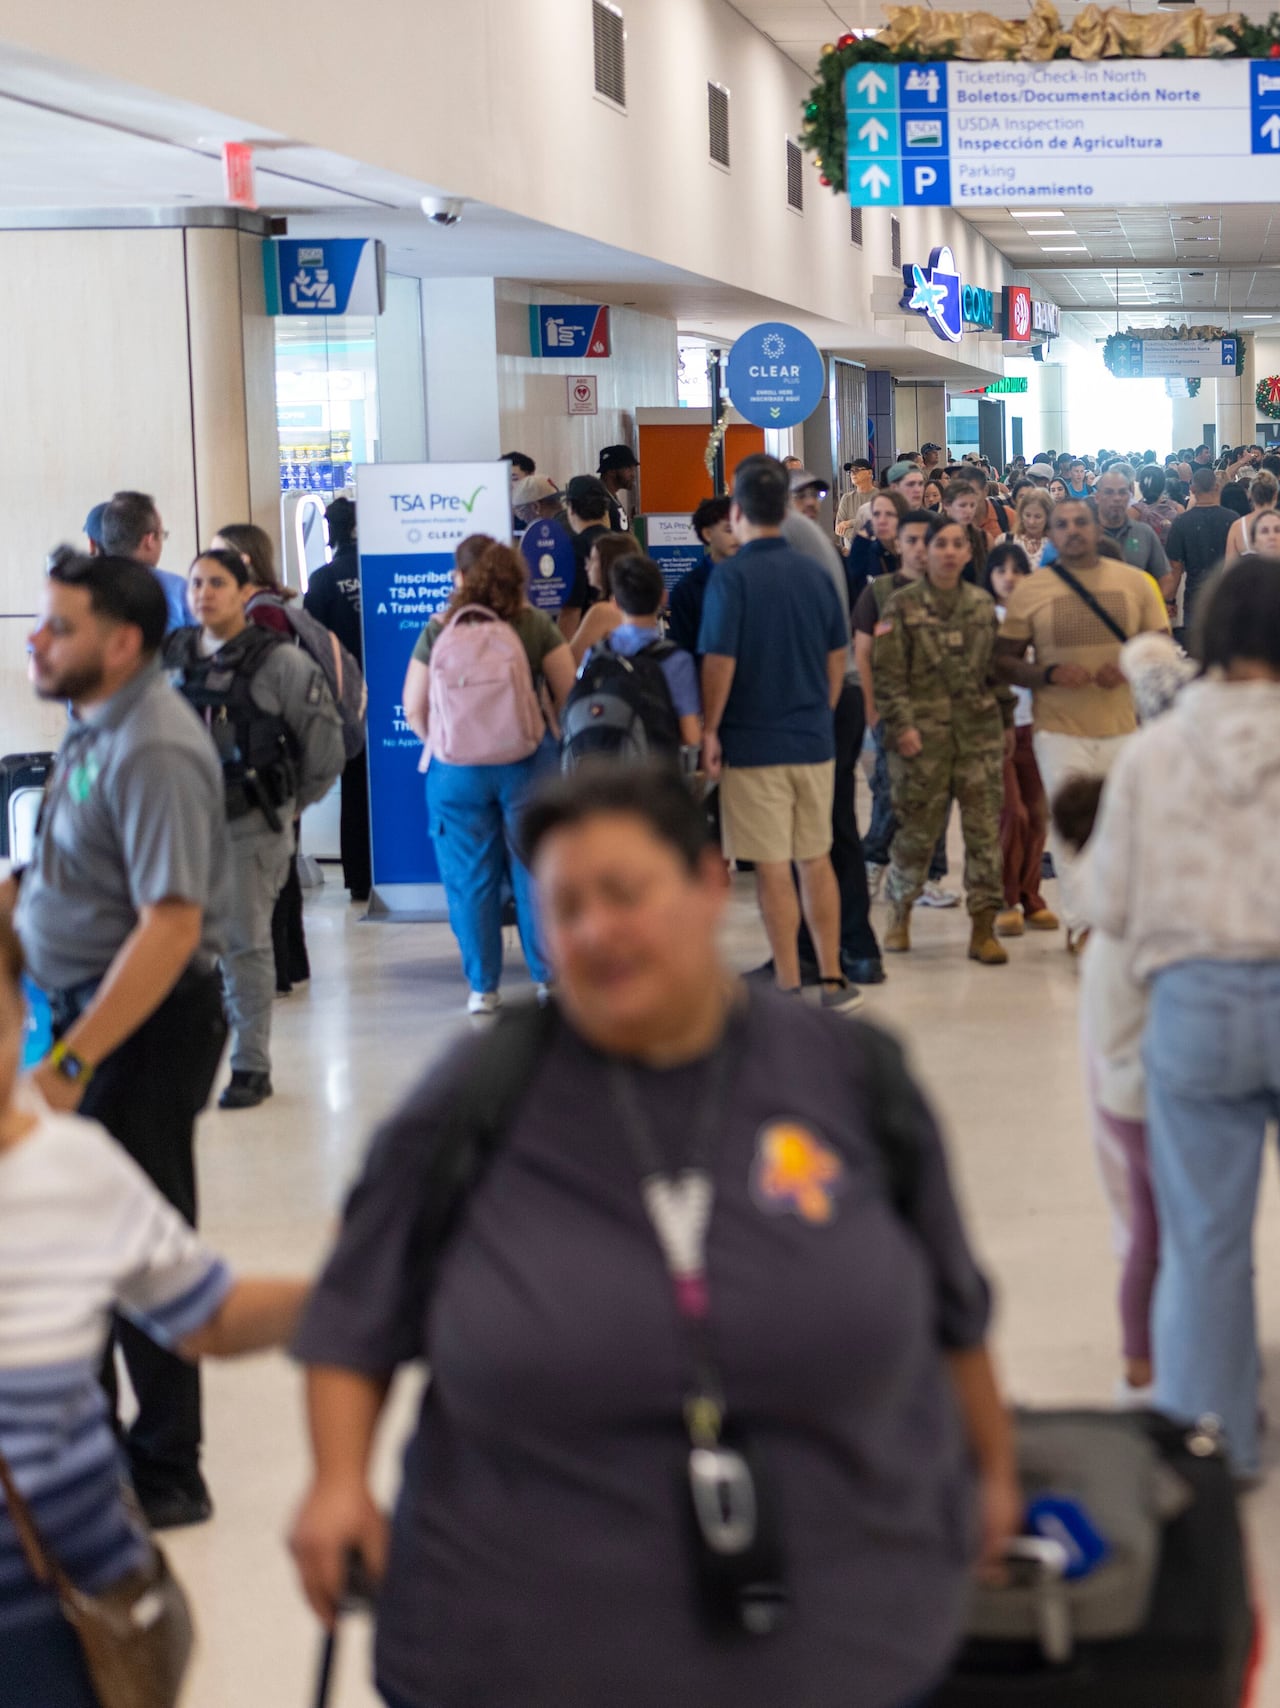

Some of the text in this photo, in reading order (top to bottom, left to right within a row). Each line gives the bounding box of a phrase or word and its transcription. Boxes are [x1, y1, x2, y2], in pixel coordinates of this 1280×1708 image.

[956, 69, 1147, 86] Ticketing/Check-In North
[957, 89, 1201, 103] Boletos/Documentación Norte
[957, 117, 1084, 133] USDA Inspection
[958, 136, 1163, 151] Inspección de Agricultura
[959, 164, 1016, 181] Parking
[960, 184, 1093, 197] Estacionamiento
[749, 365, 800, 377] CLEAR
[390, 494, 426, 512] TSA
[389, 587, 416, 599] TSA
[377, 602, 387, 614] A
[390, 601, 433, 614] Través
